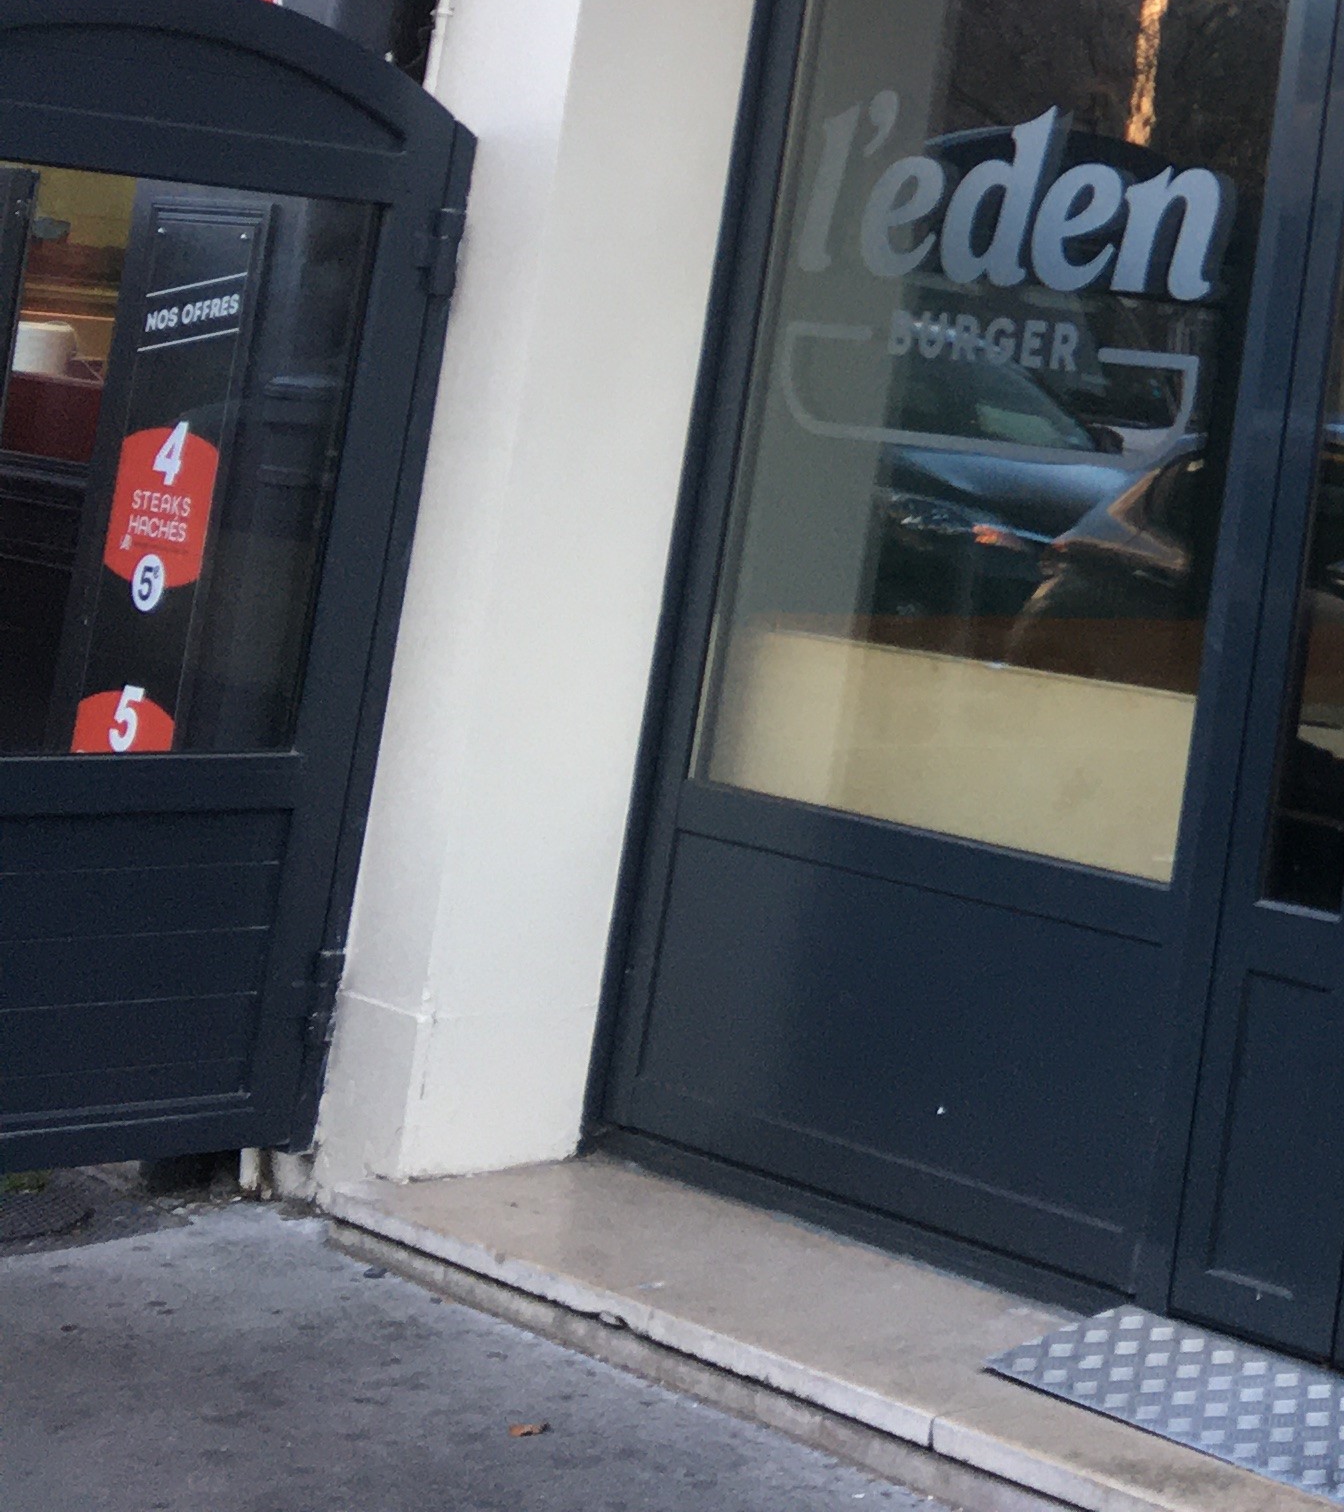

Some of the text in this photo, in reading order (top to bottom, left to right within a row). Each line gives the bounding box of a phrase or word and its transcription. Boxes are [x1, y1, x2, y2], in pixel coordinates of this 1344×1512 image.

[803, 91, 1221, 301] l'eden
[145, 294, 240, 332] NOS OFFRES
[887, 309, 1080, 372] BURGER
[152, 421, 190, 486] 4
[128, 513, 187, 543] HACHÉS
[132, 489, 191, 517] STEAKS
[109, 685, 145, 752] 5
